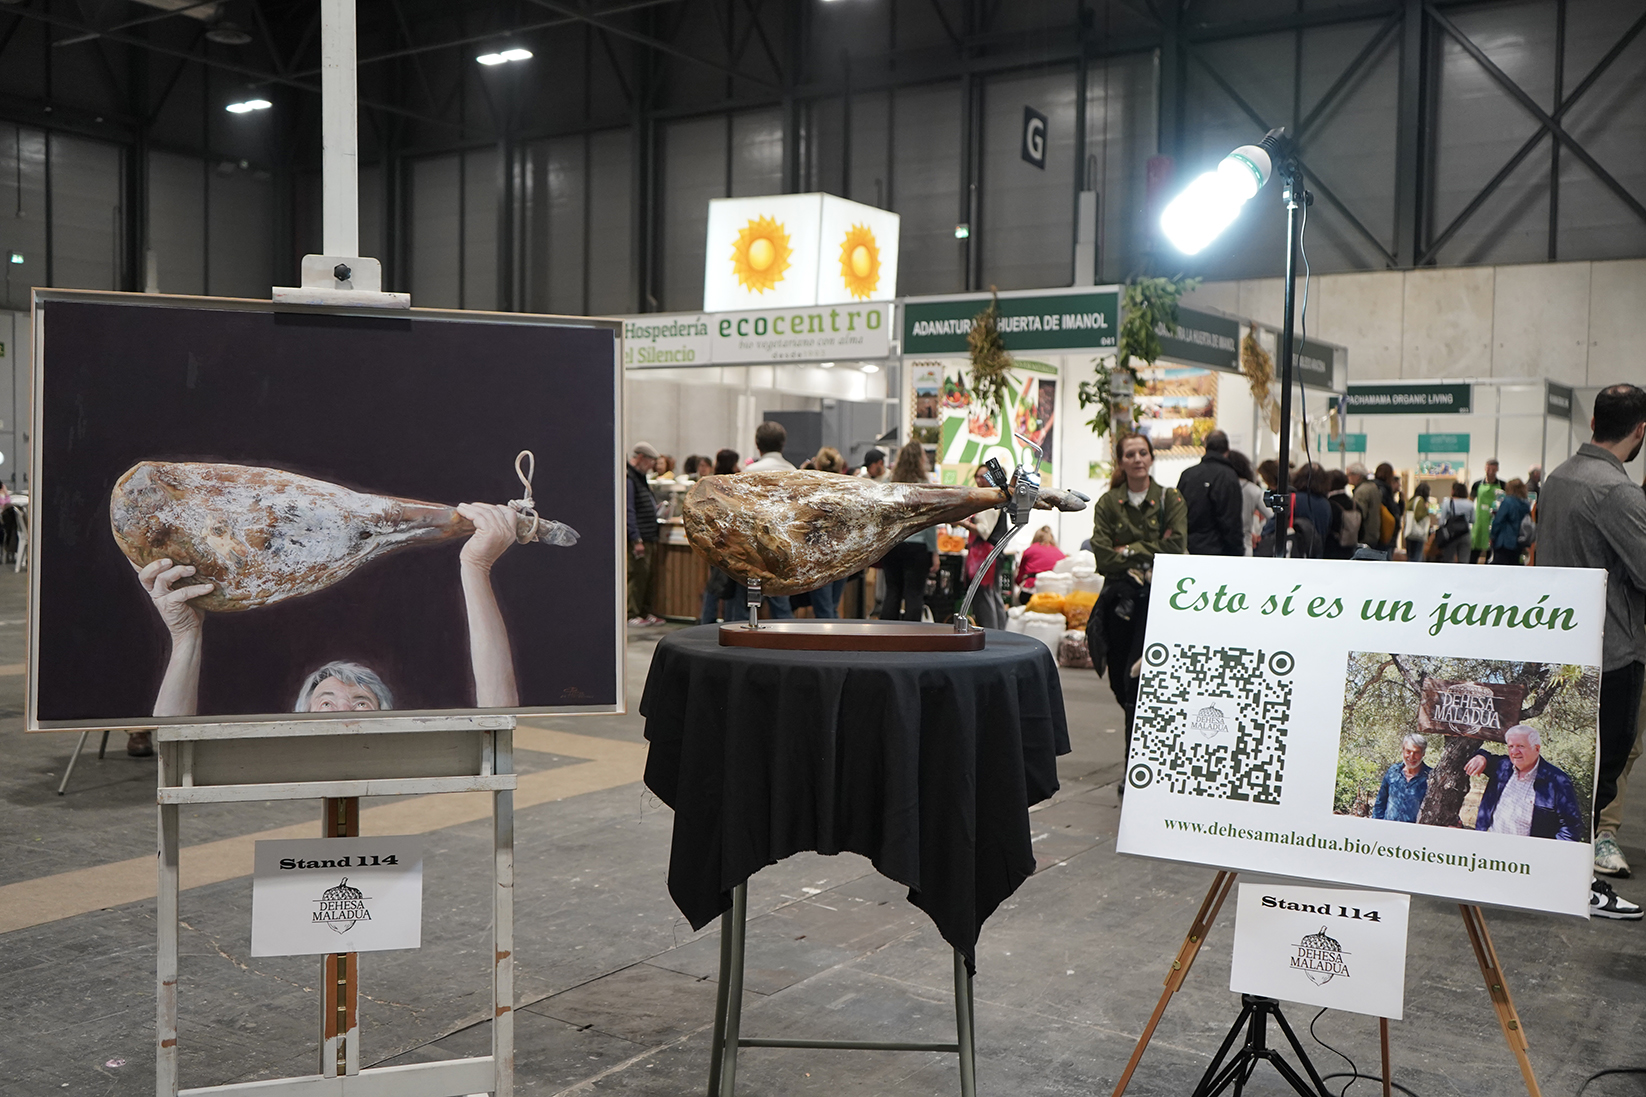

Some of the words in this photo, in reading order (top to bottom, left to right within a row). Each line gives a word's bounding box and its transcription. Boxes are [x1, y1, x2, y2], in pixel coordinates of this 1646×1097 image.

[1026, 117, 1044, 160] G
[625, 316, 708, 342] Hospedería
[719, 309, 882, 337] ecocentro
[996, 315, 1042, 333] HUERTA
[1043, 314, 1060, 331] DE
[1061, 312, 1108, 330] IMANOL
[637, 344, 696, 364] Silencio
[1392, 393, 1427, 405] ORGANIC
[1428, 393, 1454, 405] LIVING
[1169, 577, 1249, 613] Esto
[1260, 584, 1302, 616] sí
[1307, 596, 1344, 619] es
[1360, 599, 1416, 622] un
[1428, 593, 1578, 636] jamón
[1442, 692, 1495, 711] DEHESA
[1164, 818, 1532, 875] www.dehesamaladua.bio/estosiesunjamon
[279, 856, 352, 870] Stand
[357, 855, 399, 867] 114
[320, 900, 365, 911] DEHESA
[1261, 895, 1331, 915] Stand
[1338, 906, 1382, 922] 114
[1297, 947, 1343, 964] DEHESA
